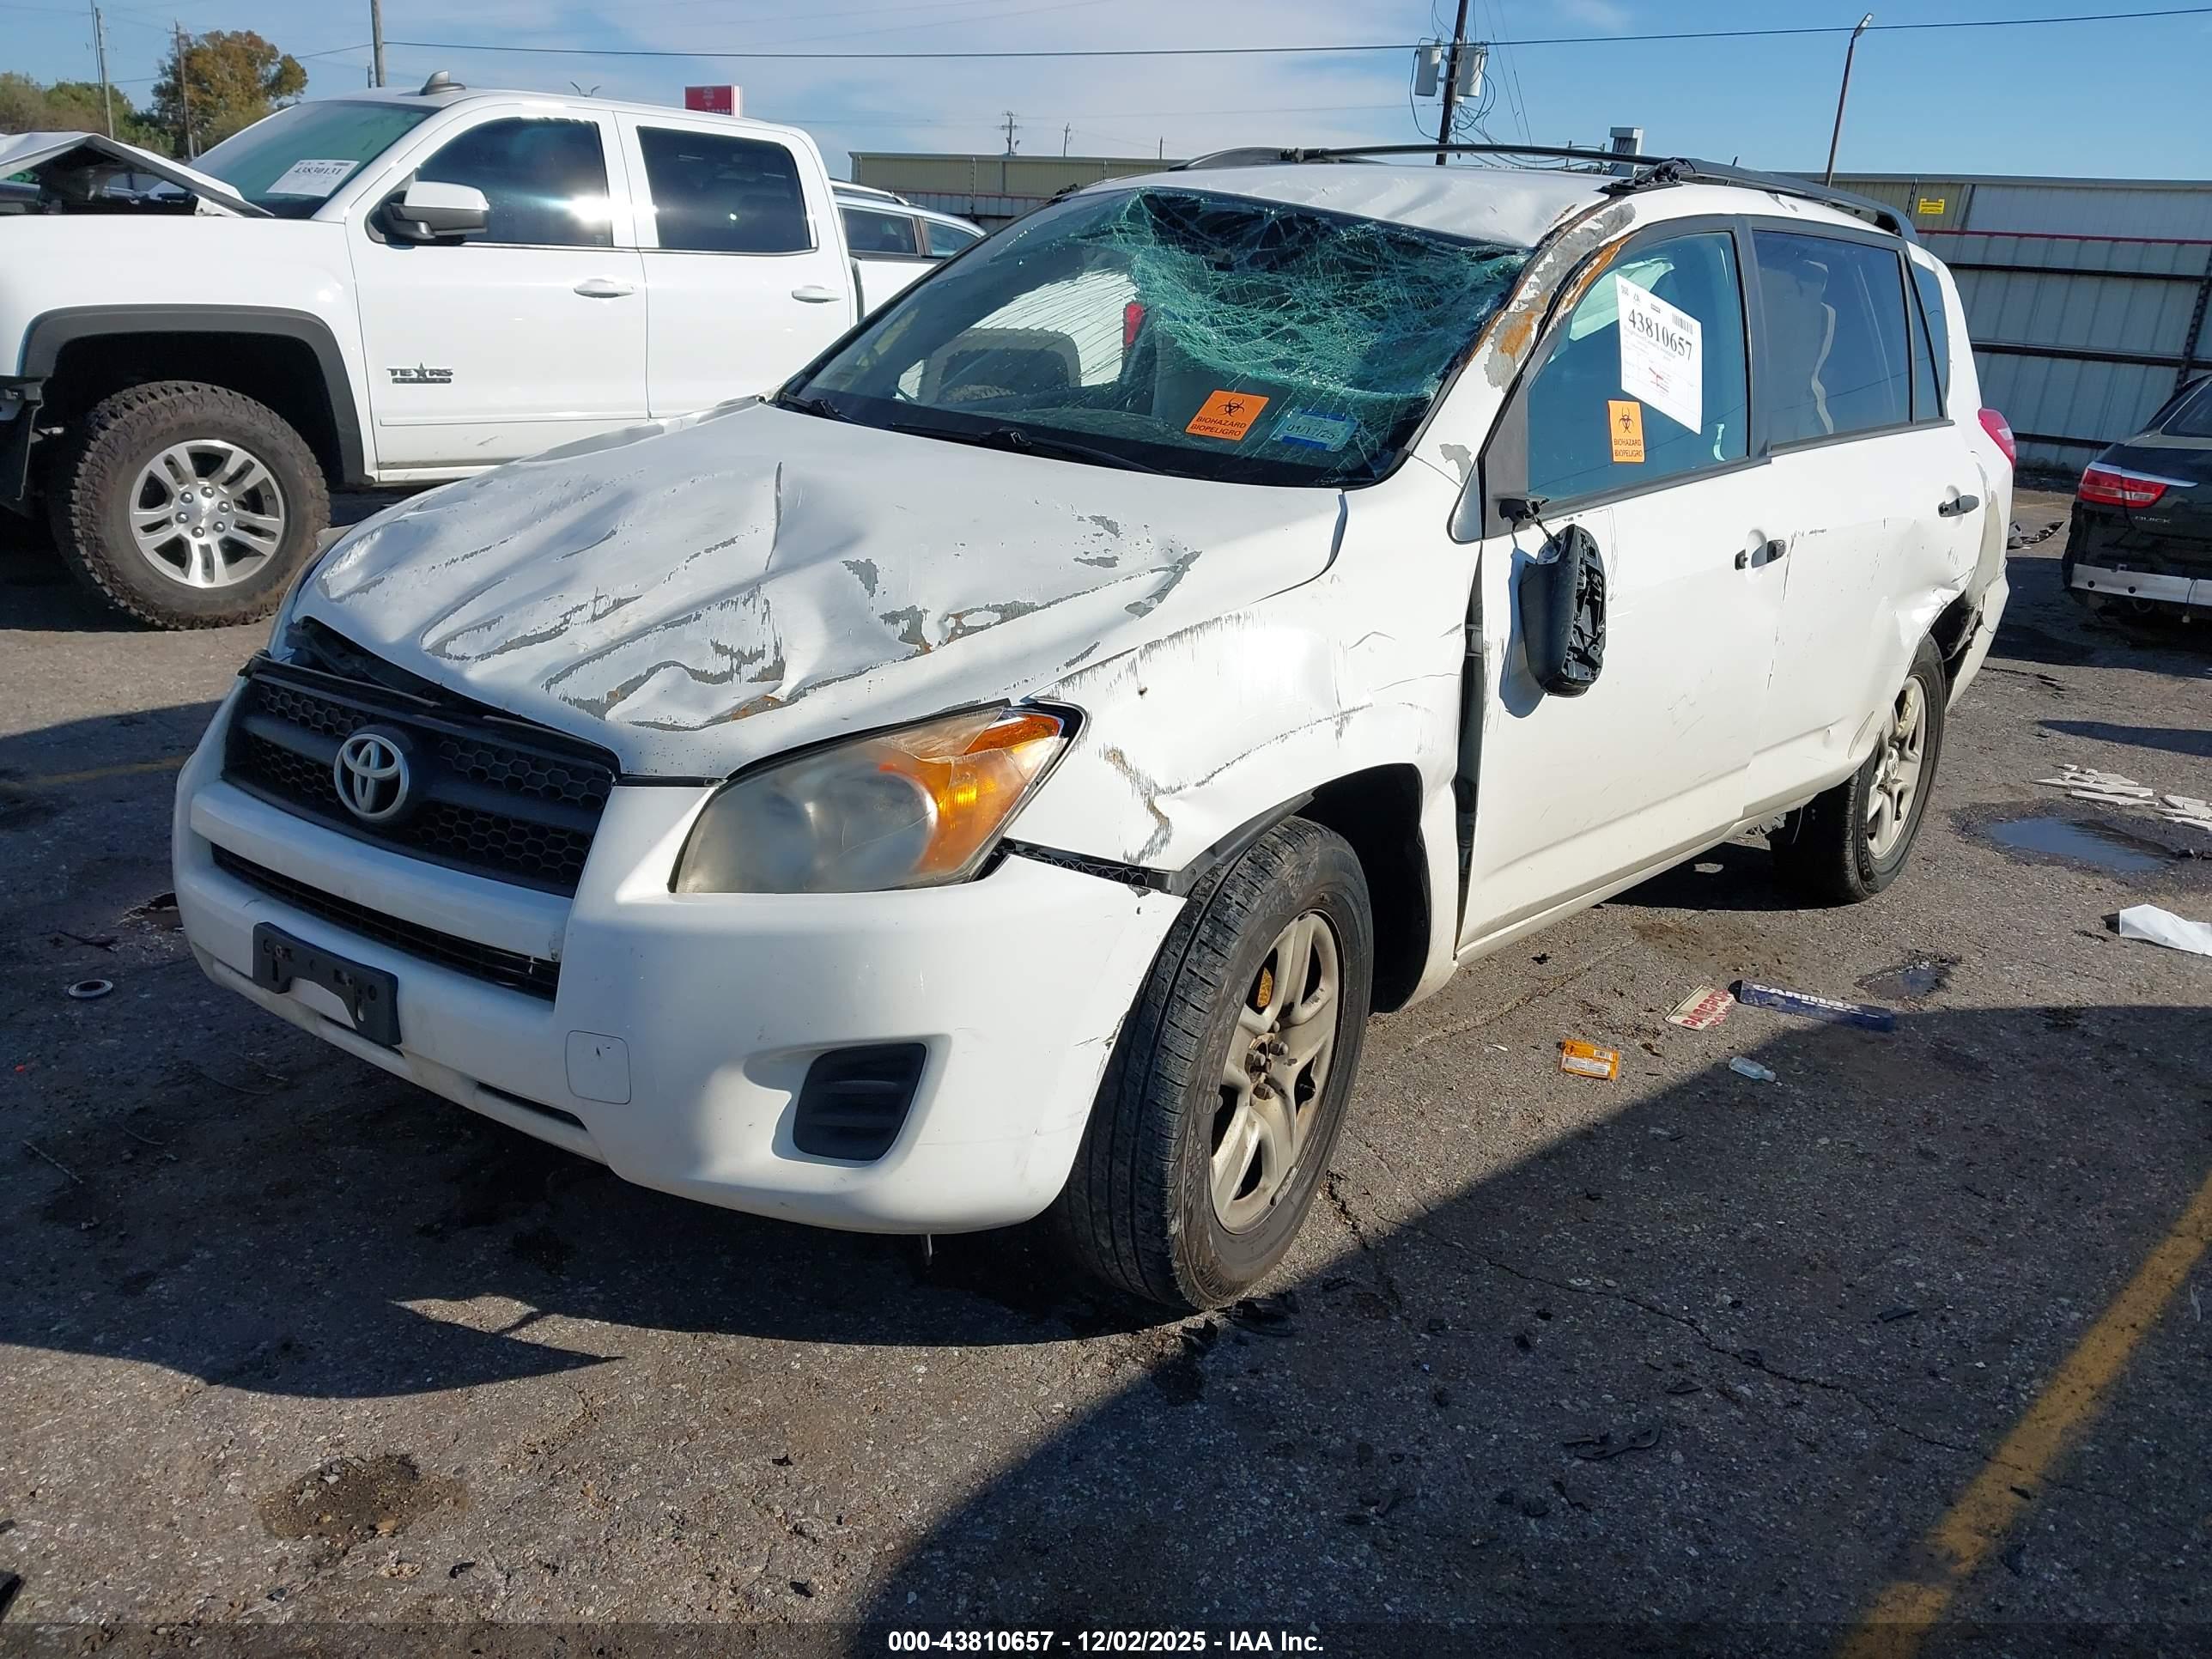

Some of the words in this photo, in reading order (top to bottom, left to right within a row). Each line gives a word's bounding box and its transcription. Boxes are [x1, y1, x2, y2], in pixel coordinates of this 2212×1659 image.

[1628, 308, 1692, 361] 43810657
[1196, 416, 1247, 428] BIOHAZARD
[1190, 423, 1242, 437] BIOPELIGRO
[1613, 438, 1642, 447] BIOHAZARD
[1614, 449, 1643, 458] BIOPELIGRO
